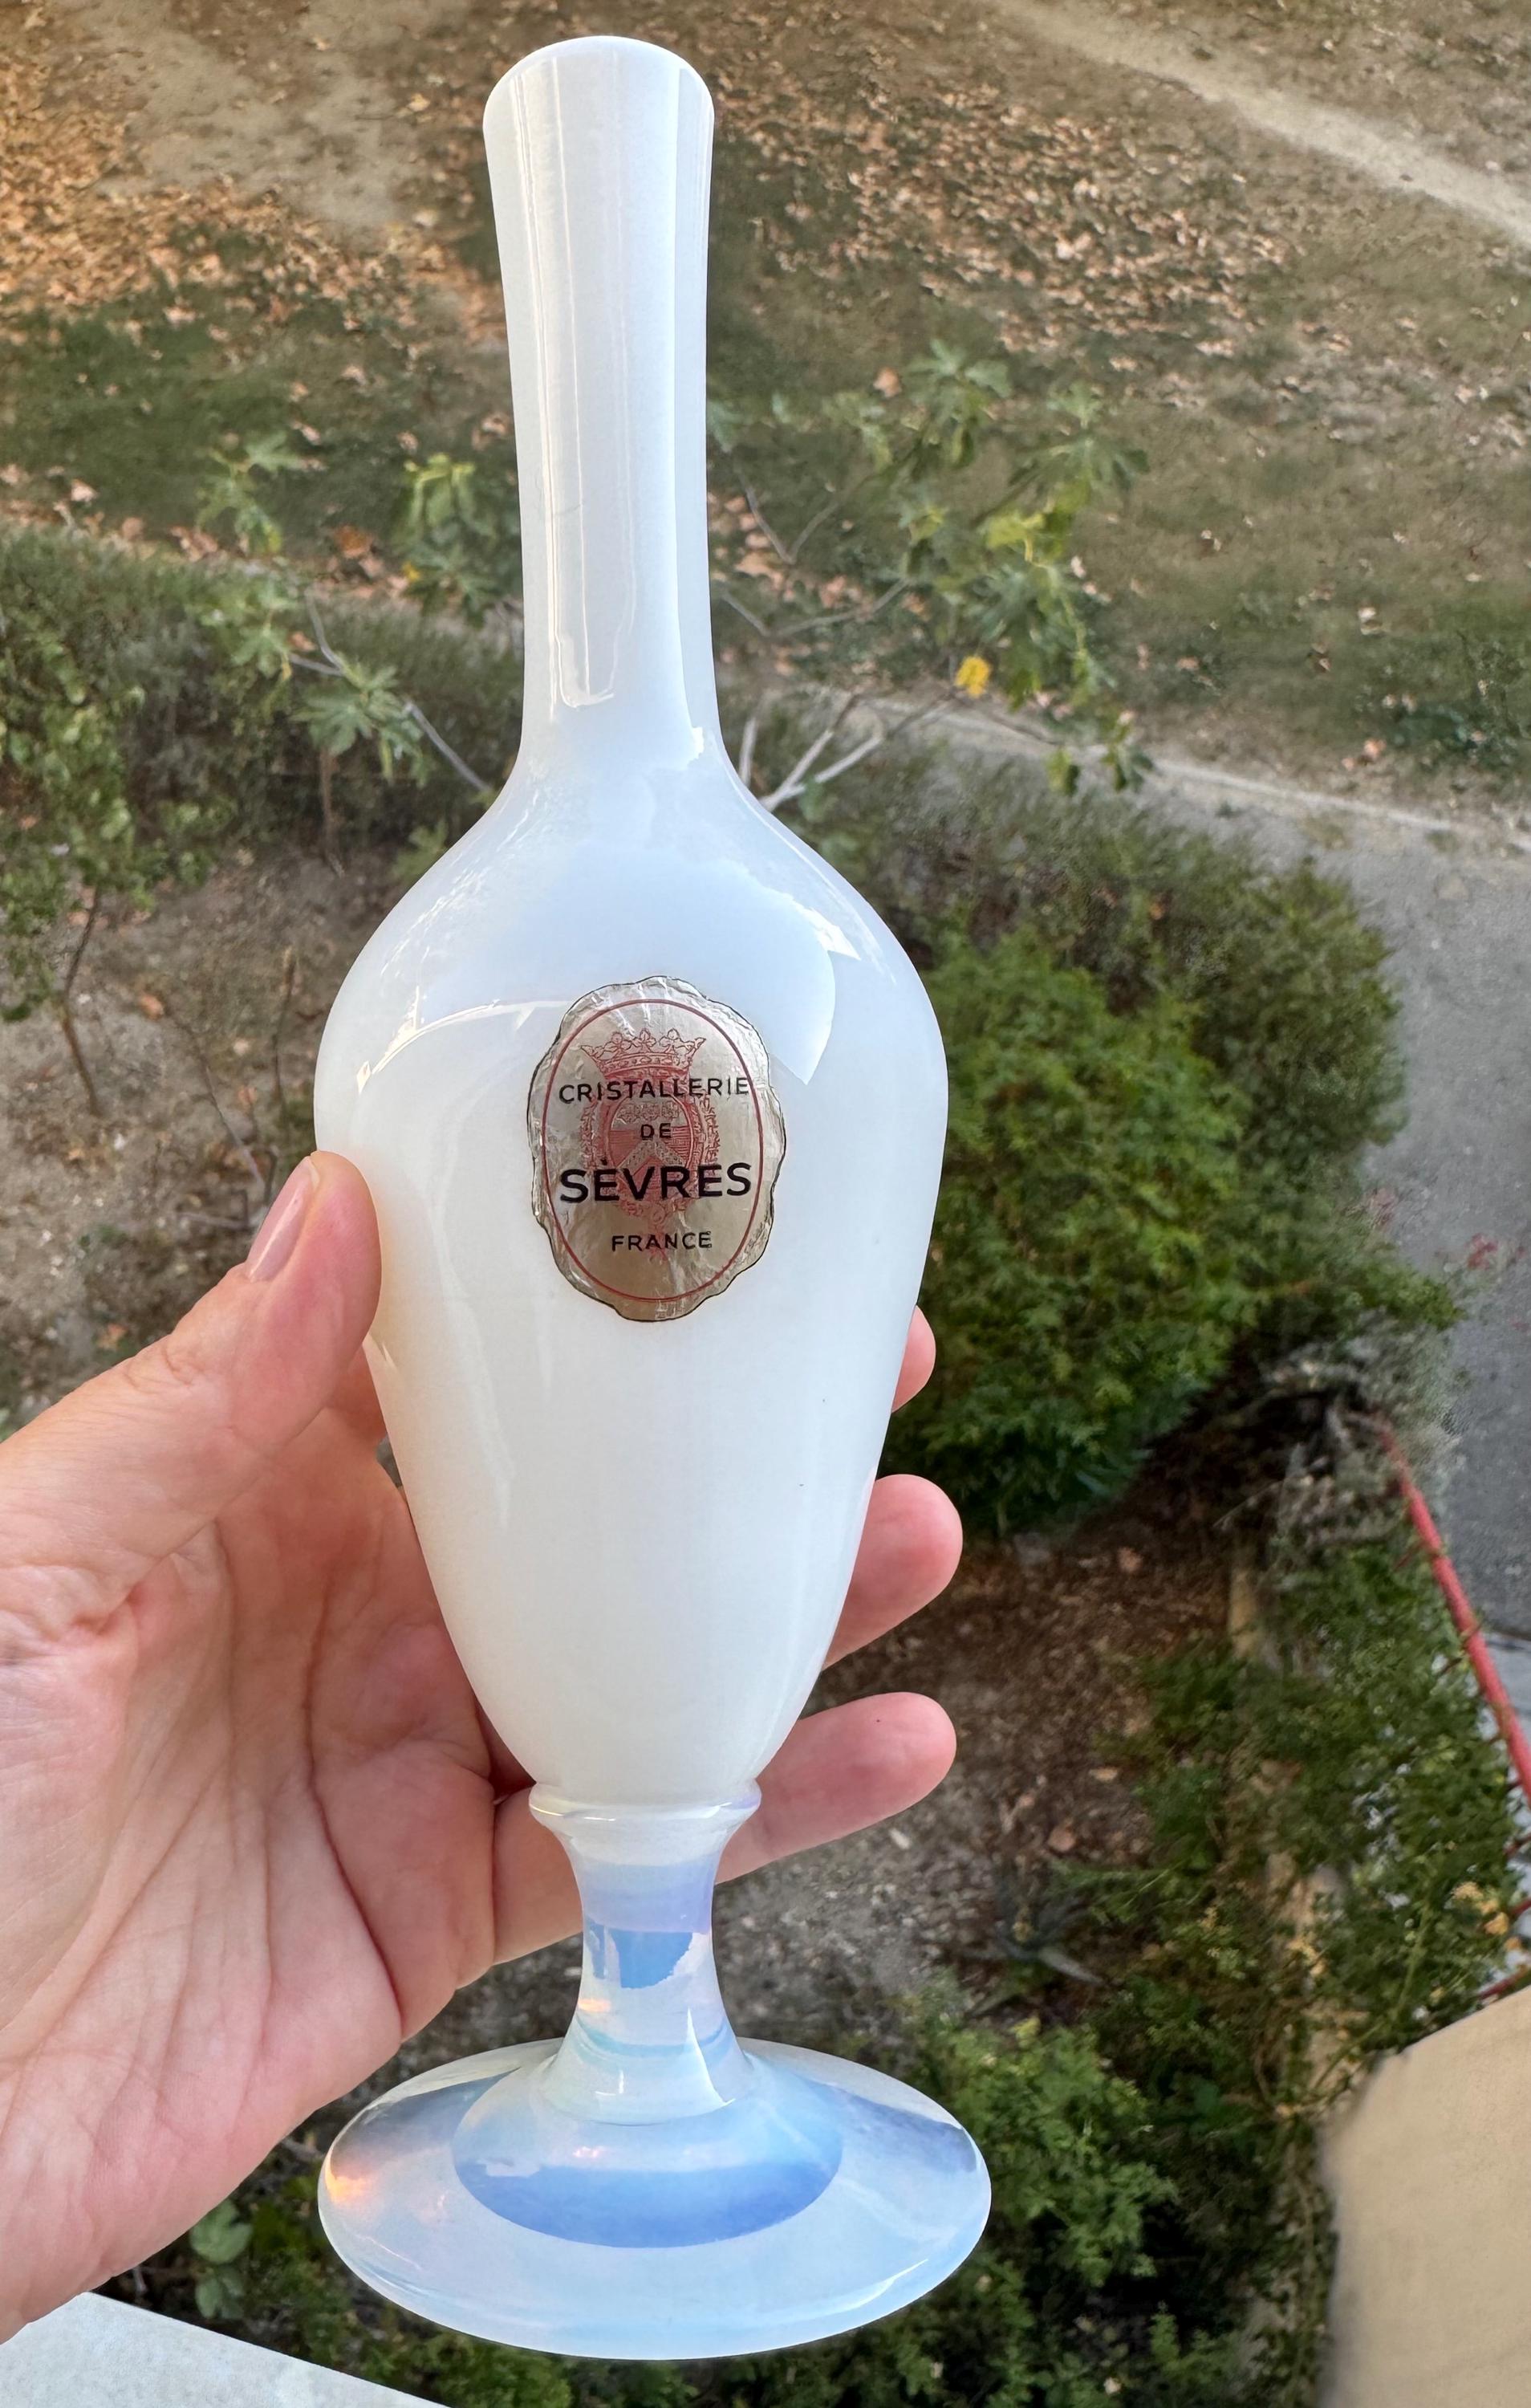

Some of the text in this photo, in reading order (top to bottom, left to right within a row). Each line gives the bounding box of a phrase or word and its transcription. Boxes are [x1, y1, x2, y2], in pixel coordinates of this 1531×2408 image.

[559, 1077, 750, 1104] CRISTALLERIE
[641, 1123, 672, 1140] DE
[611, 1231, 713, 1251] FRANCE
